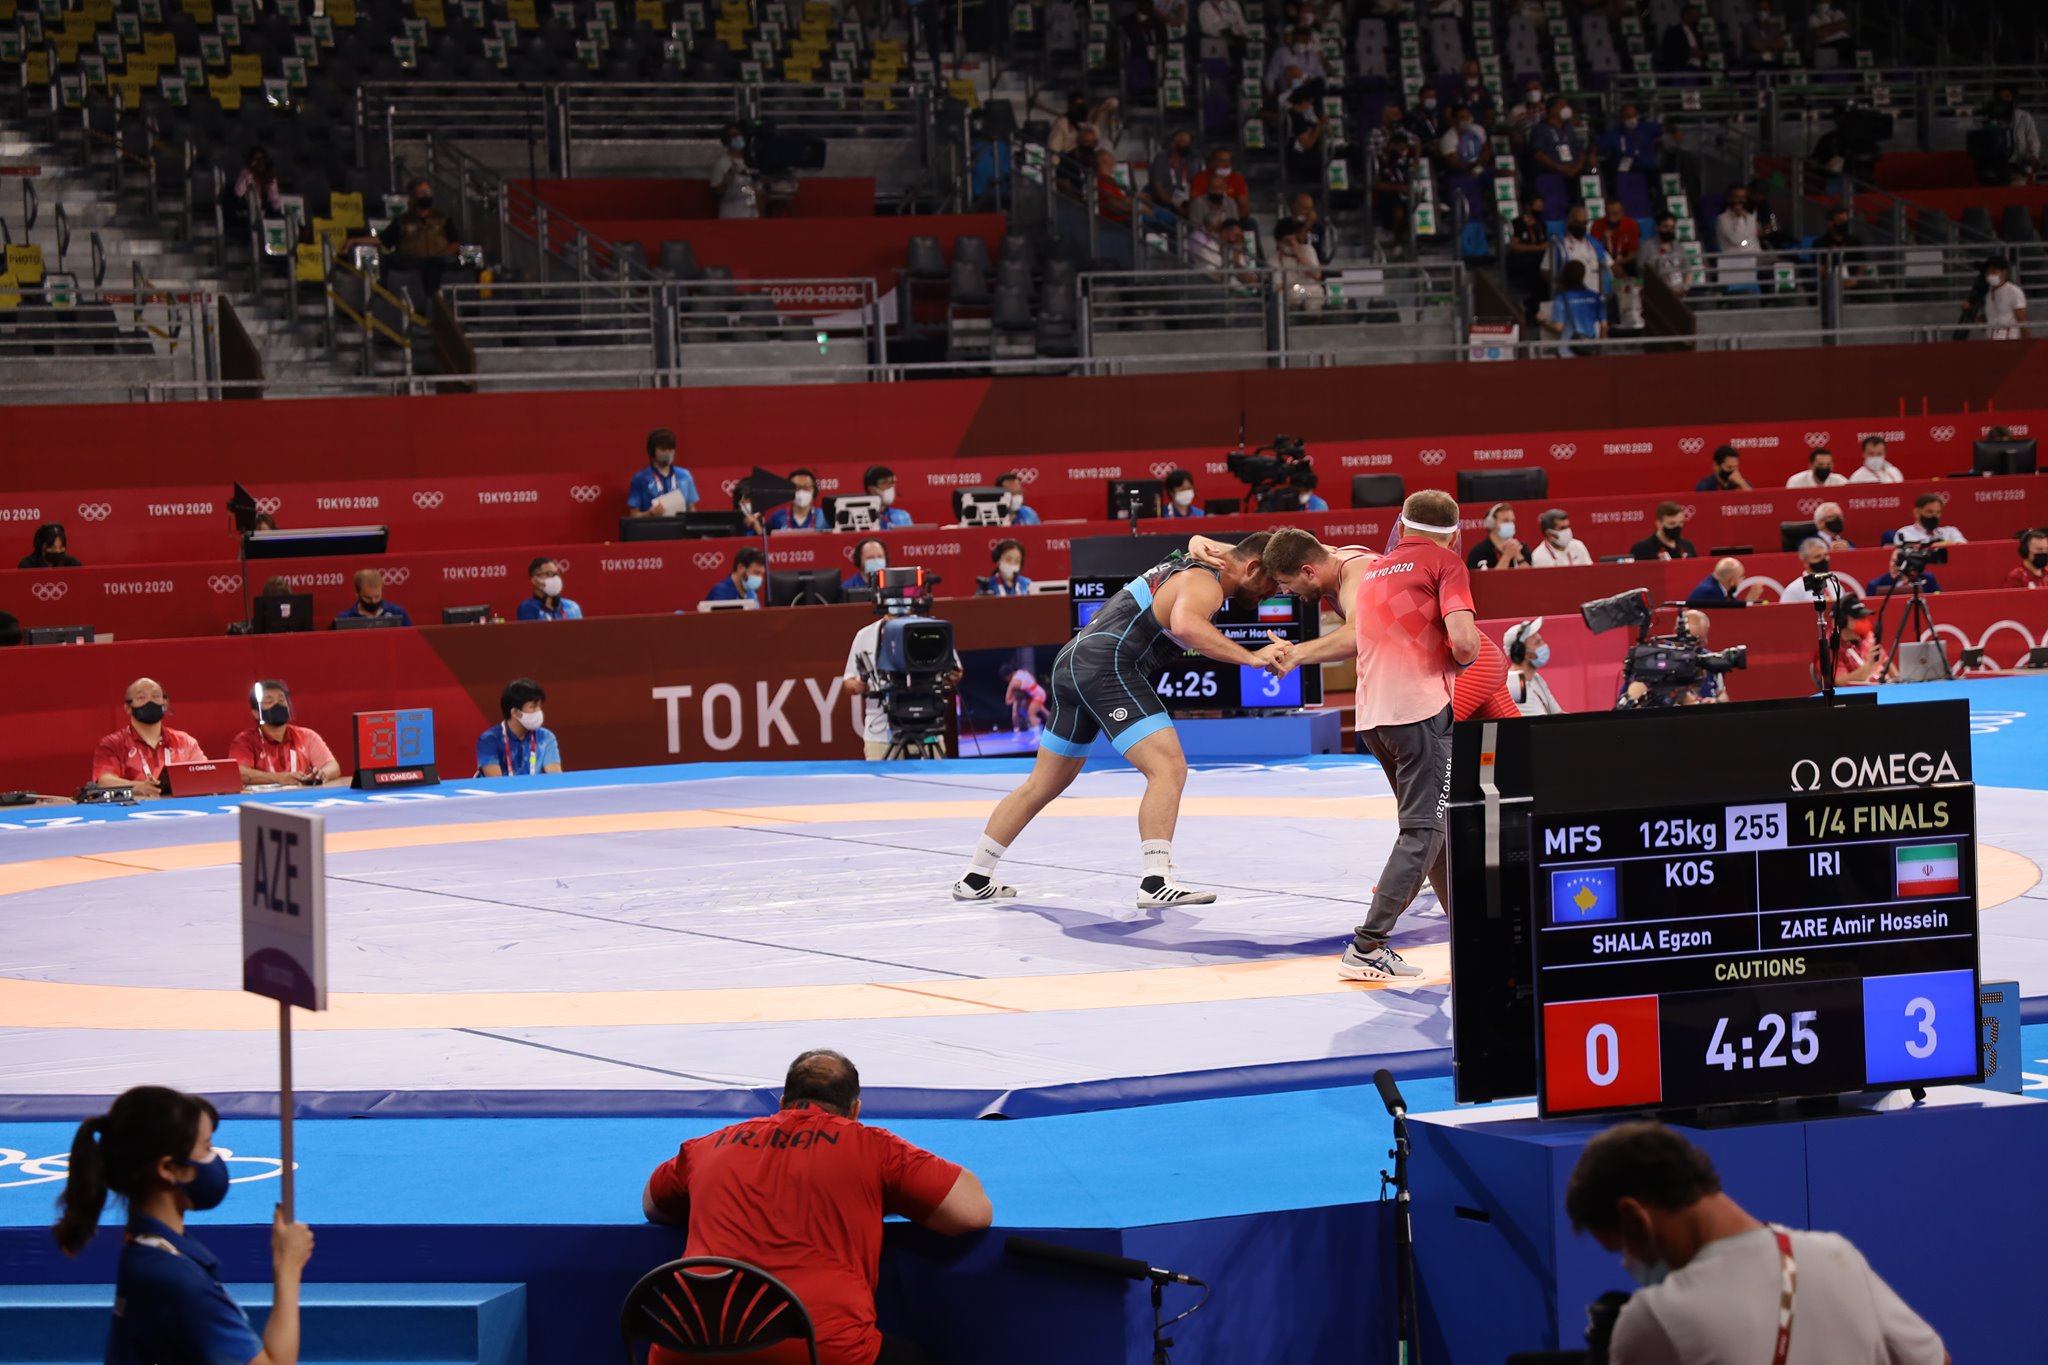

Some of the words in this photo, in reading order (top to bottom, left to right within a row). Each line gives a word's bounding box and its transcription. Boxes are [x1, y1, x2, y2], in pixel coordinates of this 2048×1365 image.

[1341, 455, 1370, 467] TOKYO
[1370, 454, 1393, 466] 2020
[926, 474, 958, 486] TOKYO
[958, 473, 982, 484] 2020
[1067, 467, 1098, 480] TOKYO
[1098, 466, 1122, 479] 2020
[315, 497, 351, 510] TOKYO
[353, 496, 379, 509] 2020
[477, 491, 511, 504] TOKYO
[512, 490, 538, 503] 2020
[12, 508, 40, 520] 2020
[147, 503, 184, 516] TOKYO
[186, 502, 213, 515] 2020
[789, 550, 815, 563] 2020
[902, 544, 935, 557] TOKYO
[935, 542, 961, 556] 2020
[600, 558, 635, 571] TOKYO
[636, 556, 663, 570] 2020
[315, 572, 344, 586] 2020
[442, 566, 478, 580] TOKYO
[479, 564, 507, 578] 2020
[1362, 566, 1389, 582] TOKYO
[1388, 562, 1415, 575] 2020
[103, 581, 142, 595] TOKYO
[144, 580, 174, 594] 2020
[1074, 582, 1105, 597] MFS
[1224, 629, 1247, 639] Amir
[1249, 628, 1288, 639] Hosein
[1156, 672, 1218, 698] 4:25
[194, 764, 217, 772] OMEGA
[1443, 757, 1453, 792] TOKYO
[1831, 750, 1960, 788] OMEGA
[390, 772, 418, 782] OMEGA
[1436, 792, 1449, 819] 2020
[1545, 826, 1602, 855] MFS
[1640, 819, 1717, 851] 125kg
[1734, 813, 1780, 841] 255
[1804, 807, 1846, 838] 1/4
[1854, 801, 1949, 834] FINALS
[253, 826, 299, 917] AZE
[1809, 852, 1841, 878] IRI
[1665, 860, 1715, 888] KOS
[1781, 918, 1828, 940] ZARE
[1832, 914, 1876, 936] Amir
[1880, 909, 1949, 931] Hossein
[1592, 935, 1654, 954] SHALA
[1659, 929, 1712, 951] Egzon
[1715, 957, 1806, 981] CAUTIONS
[1904, 996, 1938, 1059] 3
[1705, 1010, 1820, 1071] 4:25
[1585, 1022, 1619, 1087] 0
